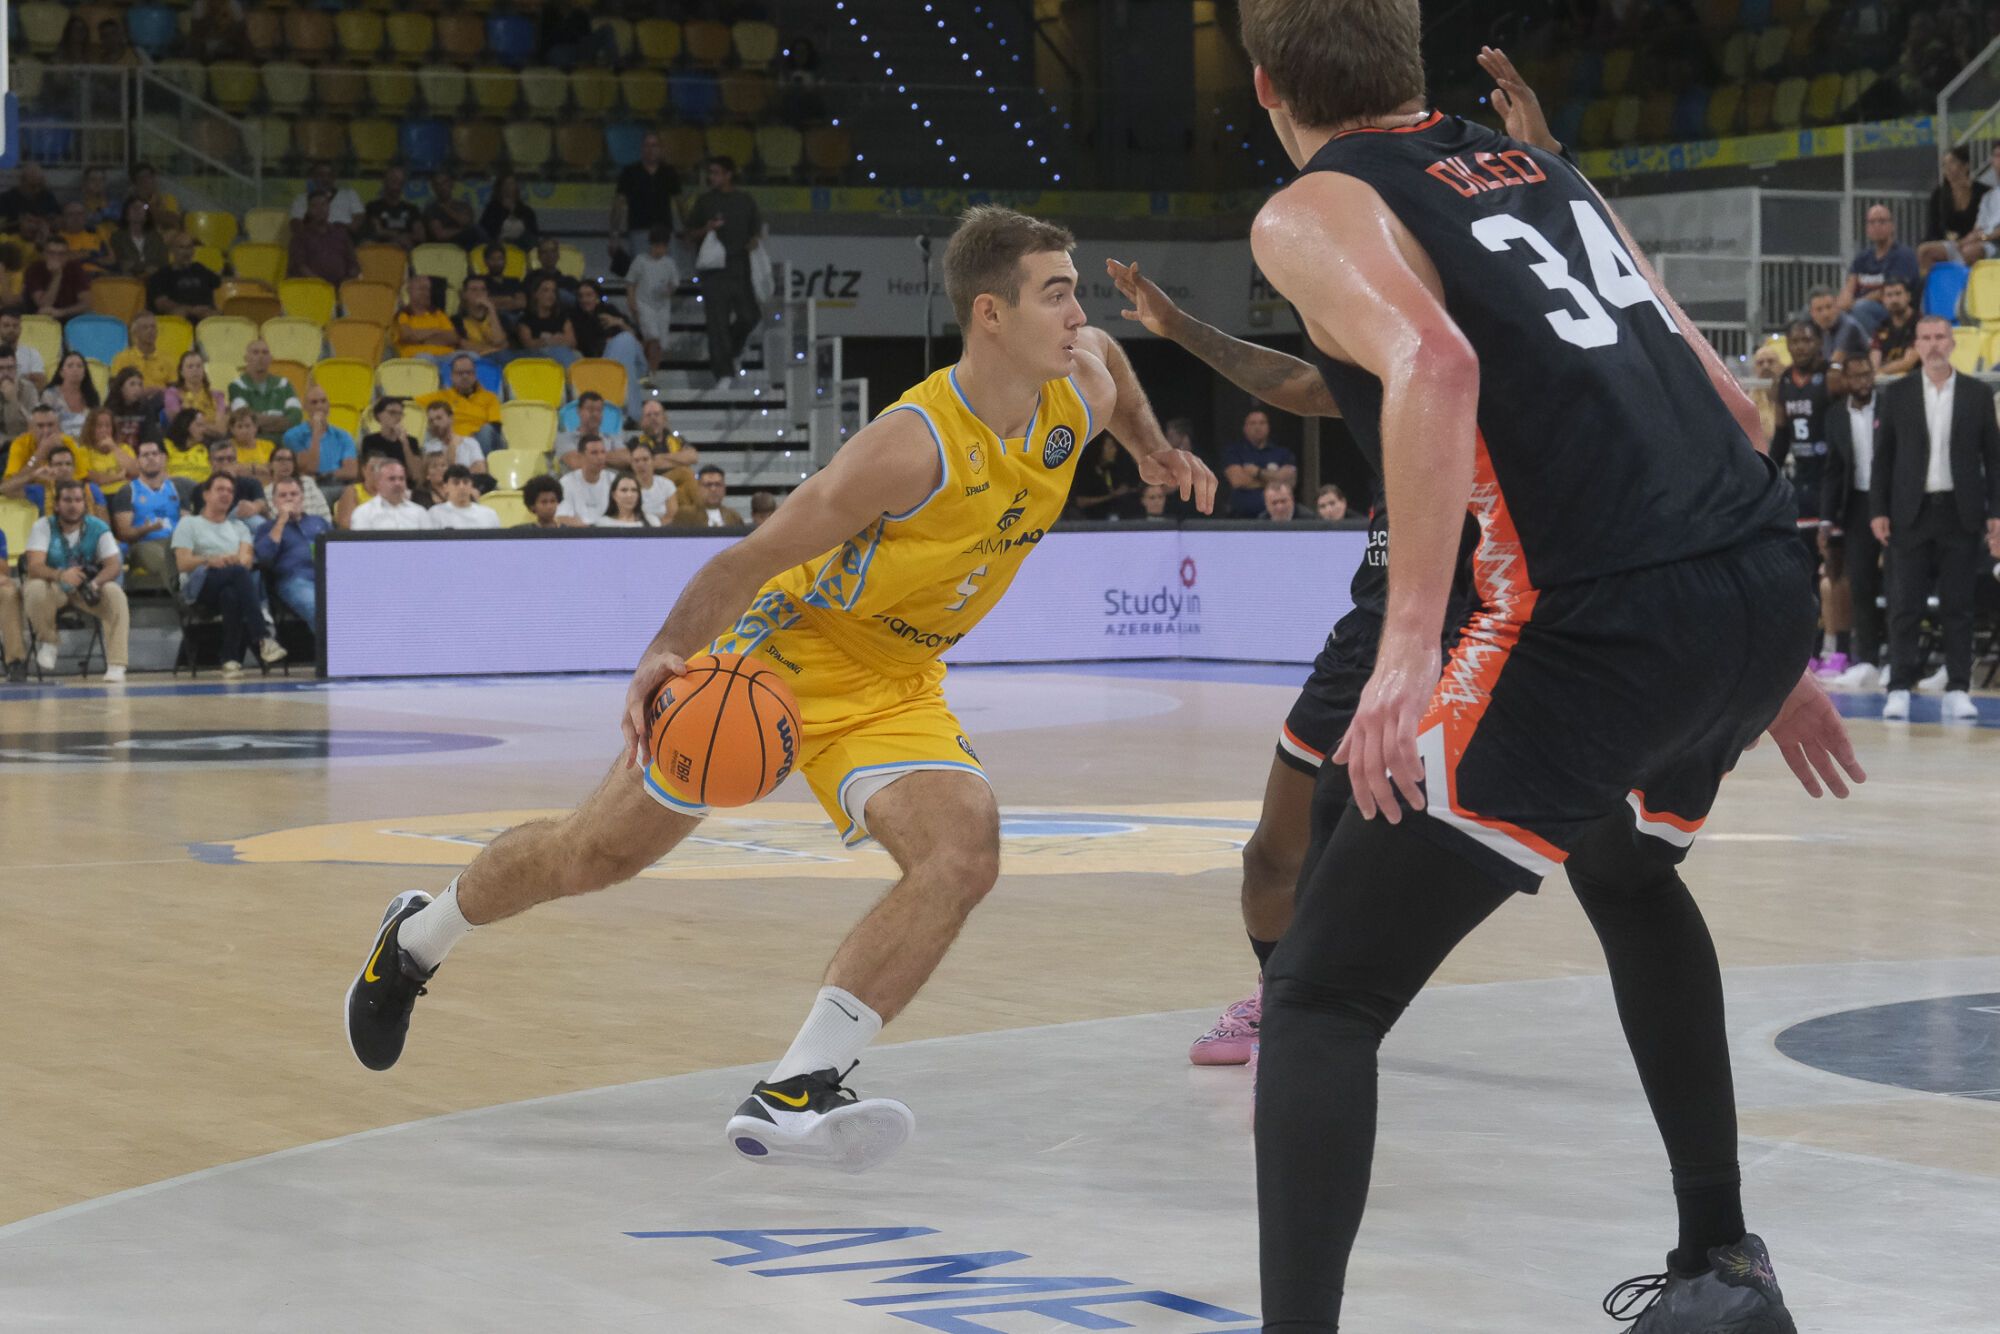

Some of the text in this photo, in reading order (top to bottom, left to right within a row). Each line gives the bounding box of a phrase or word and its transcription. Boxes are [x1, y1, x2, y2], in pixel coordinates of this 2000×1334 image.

[1426, 149, 1547, 198] DILEO
[1471, 200, 1683, 349] 34
[1104, 586, 1184, 621] Study
[766, 644, 804, 675] SPALDING
[676, 753, 693, 784] FIBA
[621, 1226, 1262, 1334] AME
